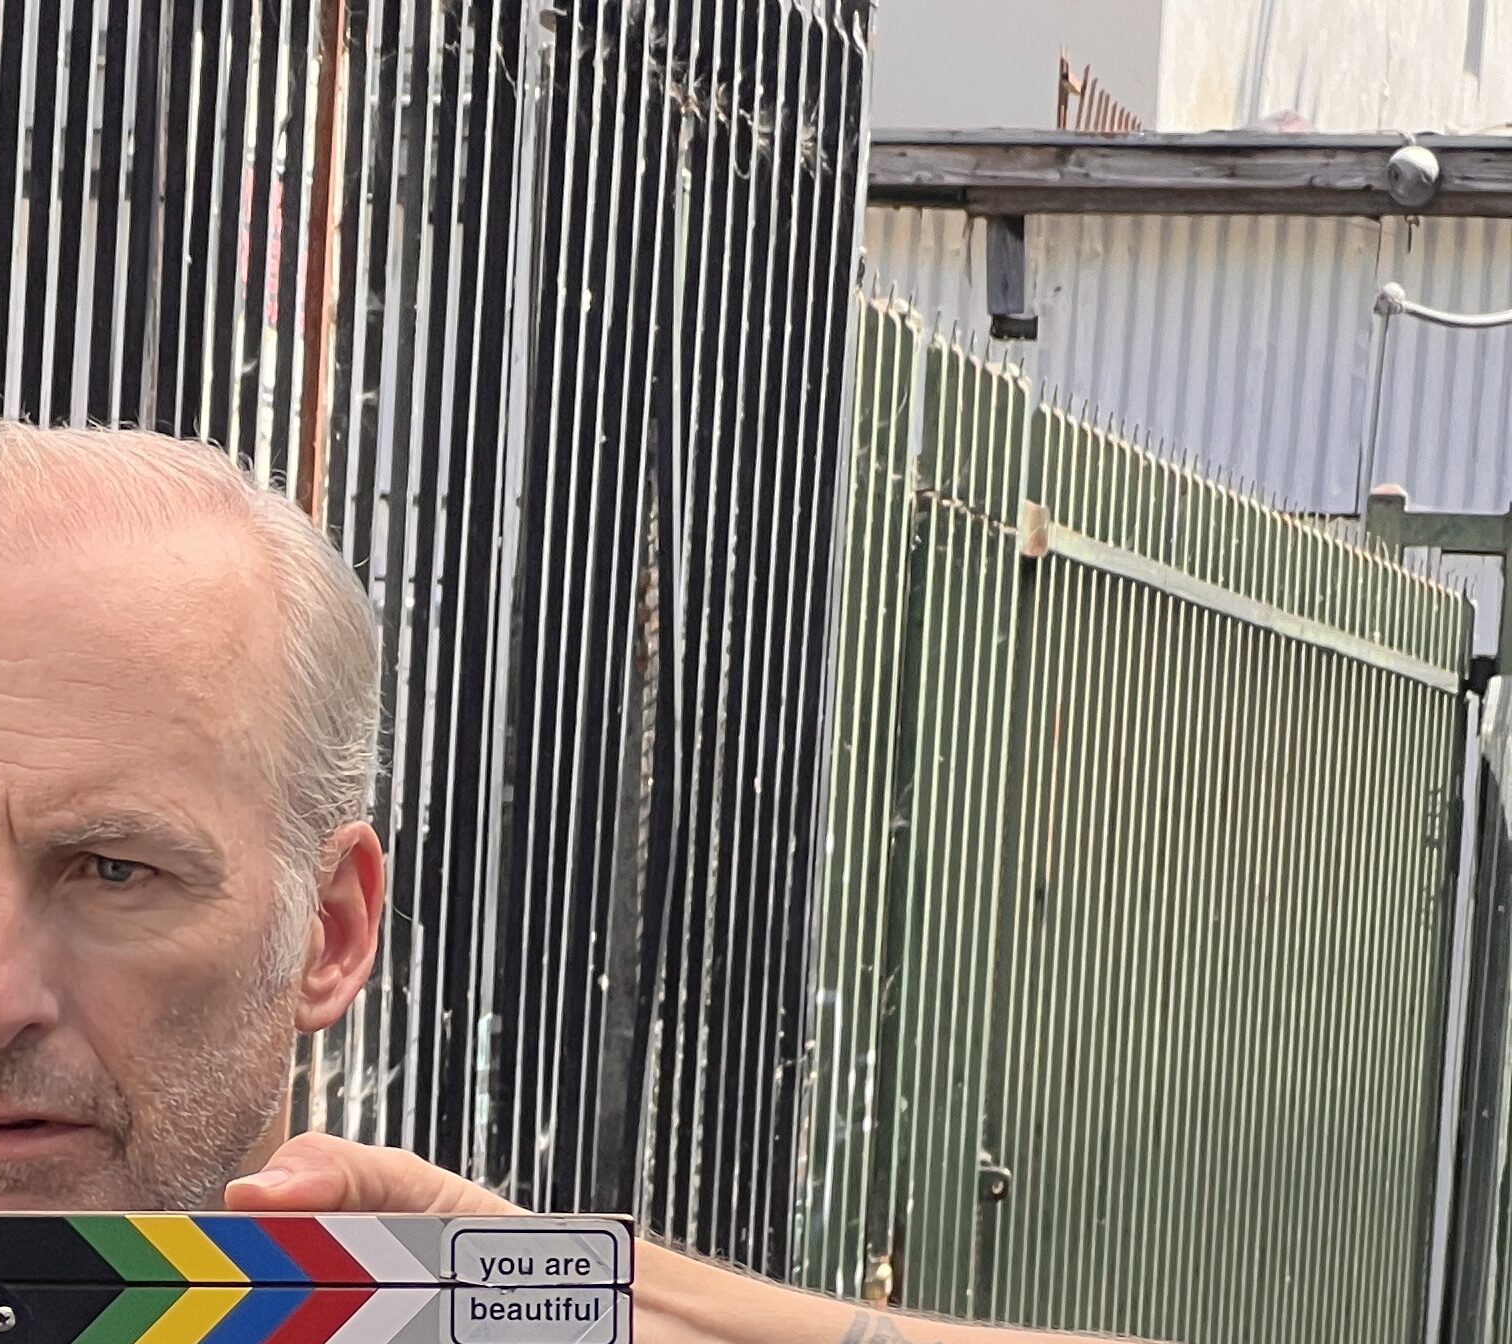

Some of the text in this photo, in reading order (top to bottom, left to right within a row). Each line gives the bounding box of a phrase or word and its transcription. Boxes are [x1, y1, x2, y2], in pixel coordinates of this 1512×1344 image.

[479, 1256, 591, 1281] you are
[470, 1297, 600, 1321] beautiful
